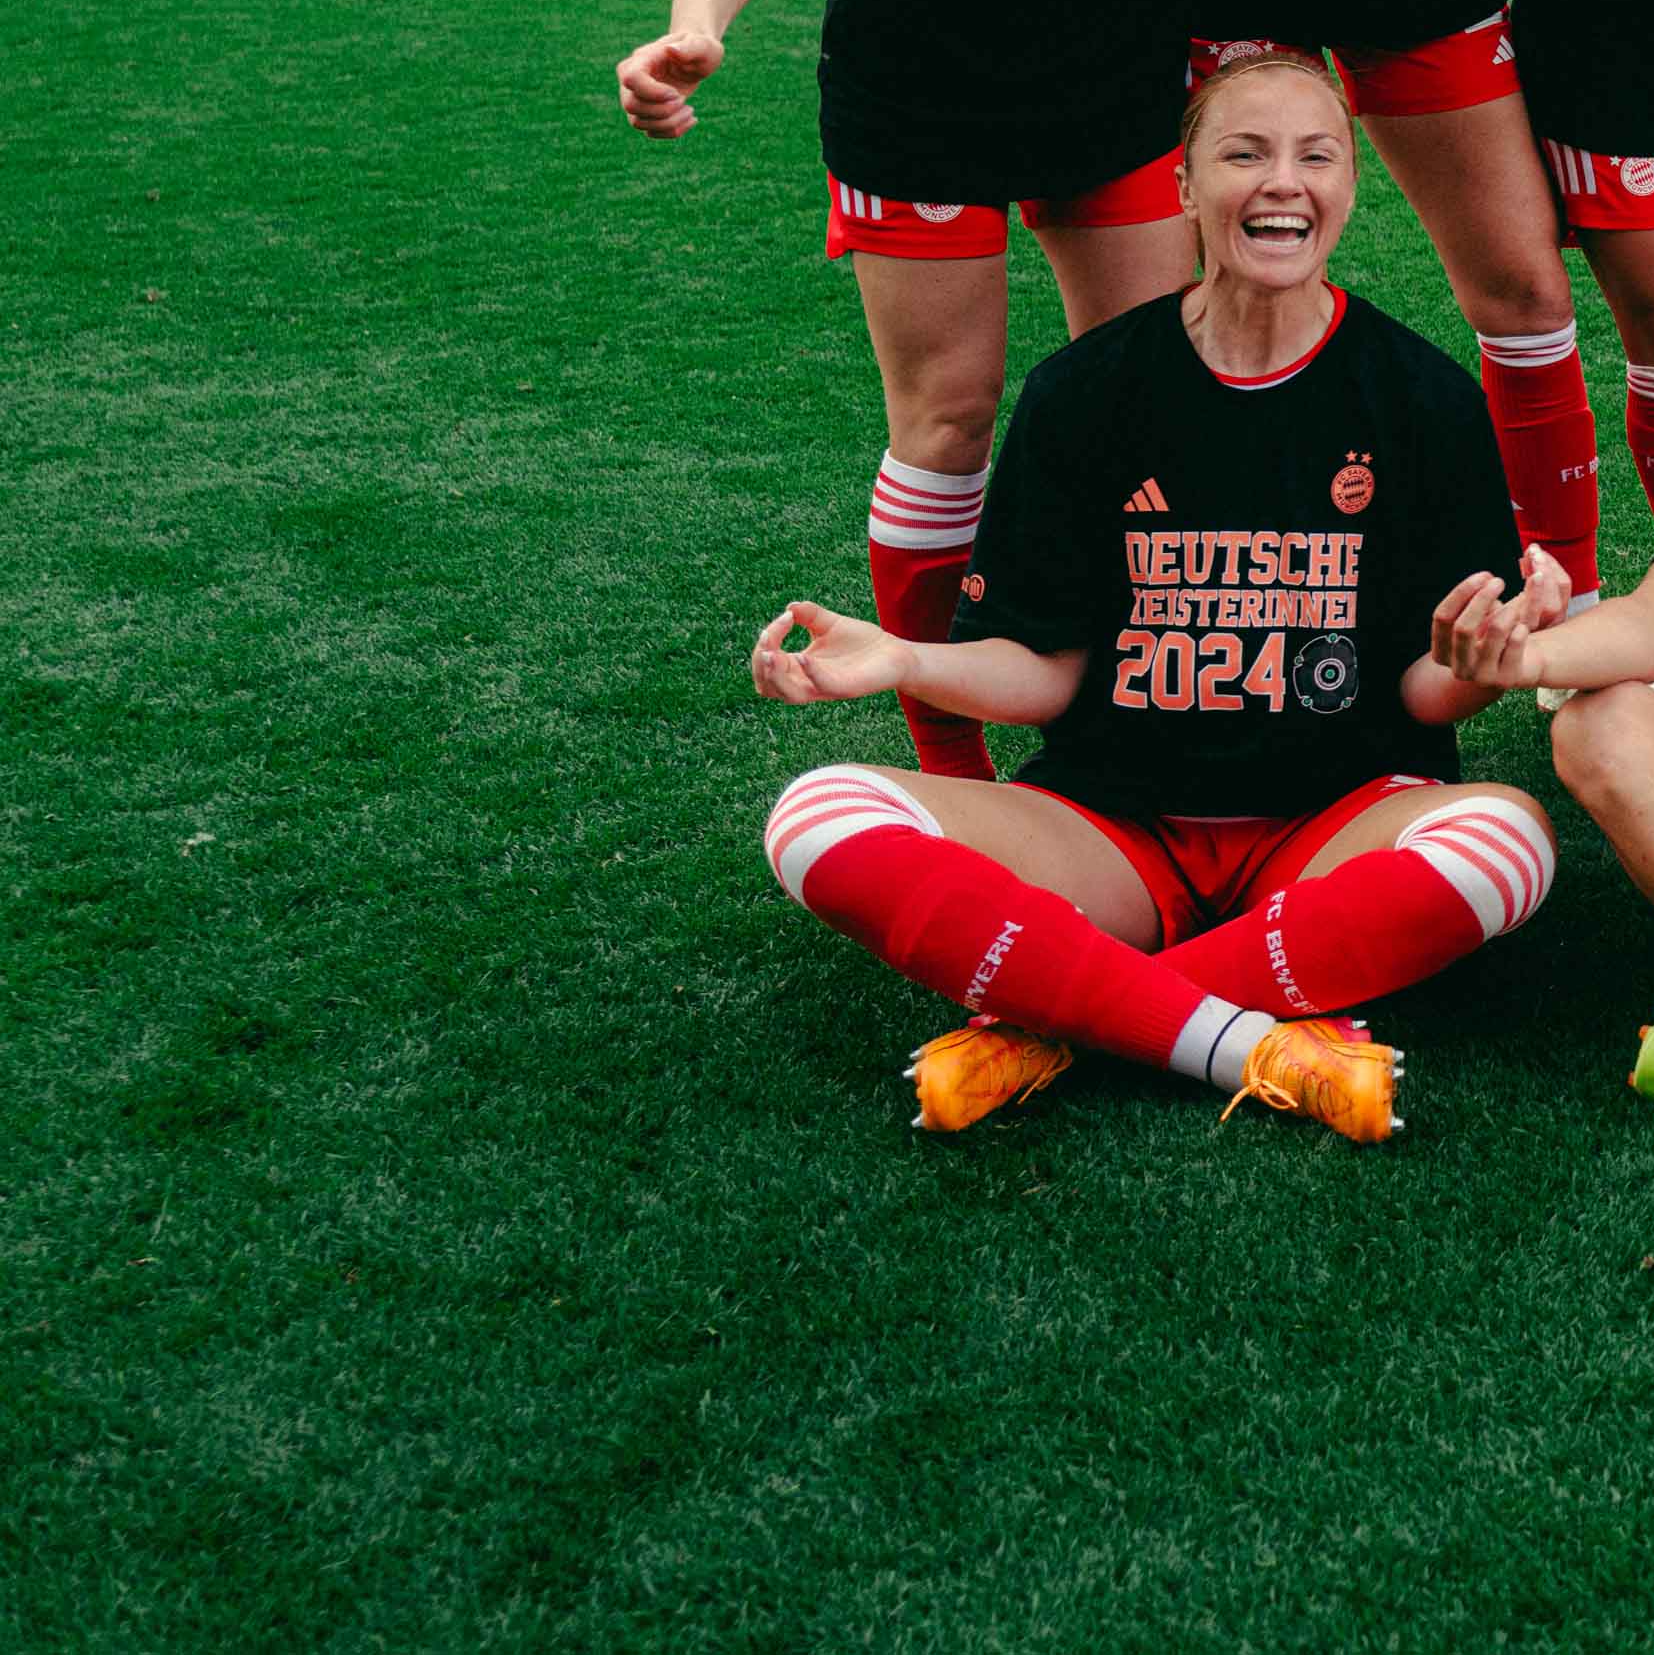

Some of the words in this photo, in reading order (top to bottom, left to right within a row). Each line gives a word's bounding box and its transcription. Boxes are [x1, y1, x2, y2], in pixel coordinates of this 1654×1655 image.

[1559, 464, 1585, 484] FC
[1125, 531, 1364, 587] DEUTSCHE
[1112, 628, 1286, 712] 2024
[1269, 889, 1287, 922] FC
